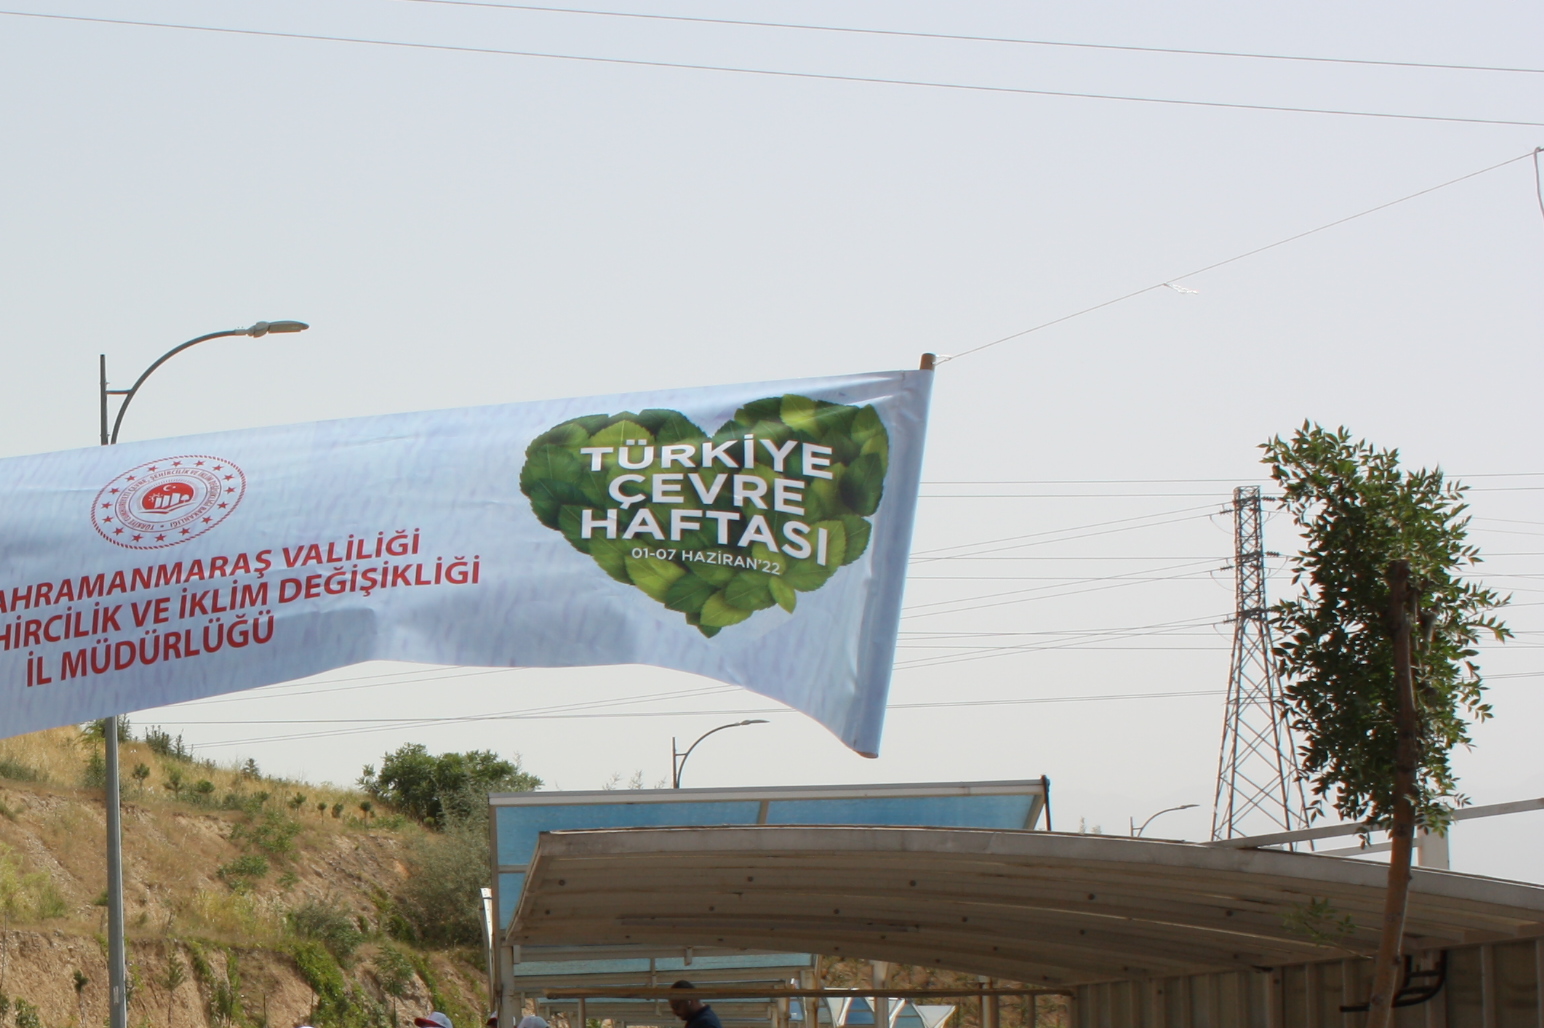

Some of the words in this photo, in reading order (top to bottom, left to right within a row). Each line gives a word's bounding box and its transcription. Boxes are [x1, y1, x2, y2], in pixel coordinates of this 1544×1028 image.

[580, 433, 834, 480] TÜRKİYE
[608, 473, 806, 516] ÇEVRE
[282, 528, 421, 568] VALİLİĞİ
[580, 507, 828, 566] HAFTASI
[631, 547, 677, 560] 01-07
[130, 597, 171, 628] VE
[178, 579, 269, 620] İKLİM
[278, 554, 481, 604] DEĞİŞİKLİĞİ
[27, 651, 53, 688] İL
[60, 609, 276, 681] MÜDÜRLÜĞÜ
